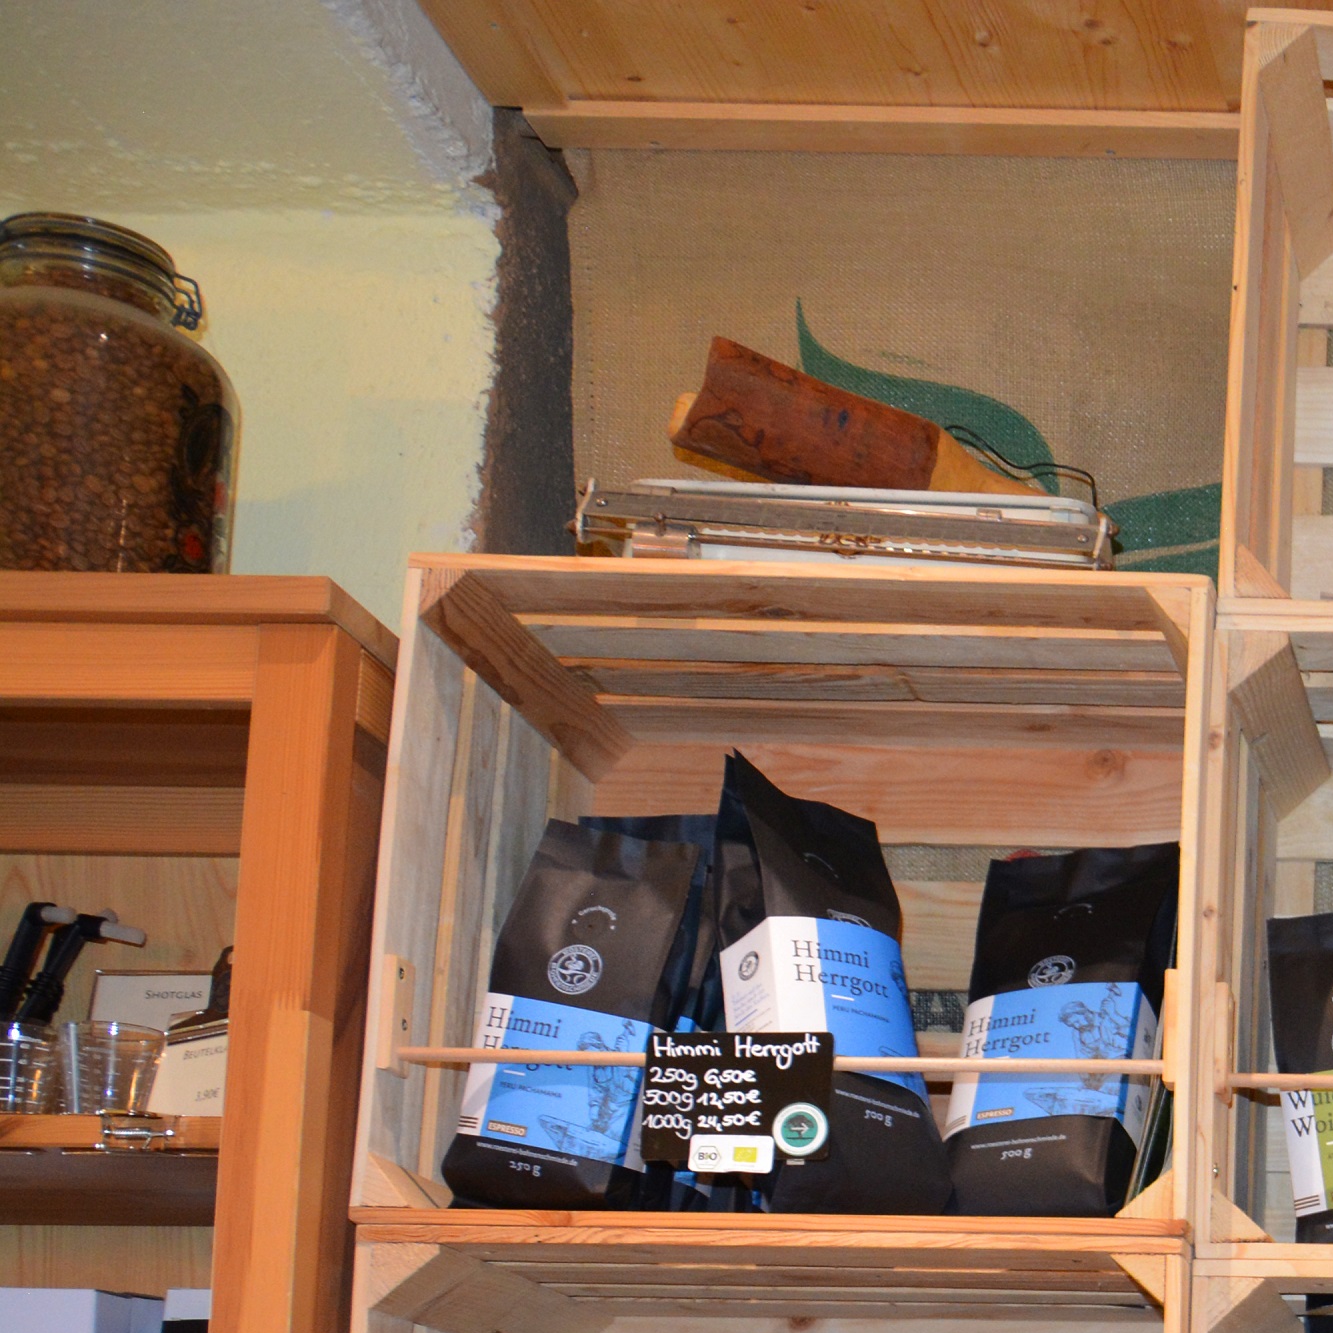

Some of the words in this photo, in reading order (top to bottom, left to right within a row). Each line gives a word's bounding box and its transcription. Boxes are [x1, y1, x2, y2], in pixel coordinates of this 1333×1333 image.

[792, 938, 870, 969] Himmi
[793, 963, 890, 999] Herrgott
[486, 1006, 562, 1039] Himmi
[968, 1008, 1037, 1037] Himmi
[653, 1034, 722, 1059] Himmi
[734, 1033, 821, 1070] Herrgott
[964, 1032, 1051, 1058] Herrgott
[648, 1067, 698, 1092] 250g
